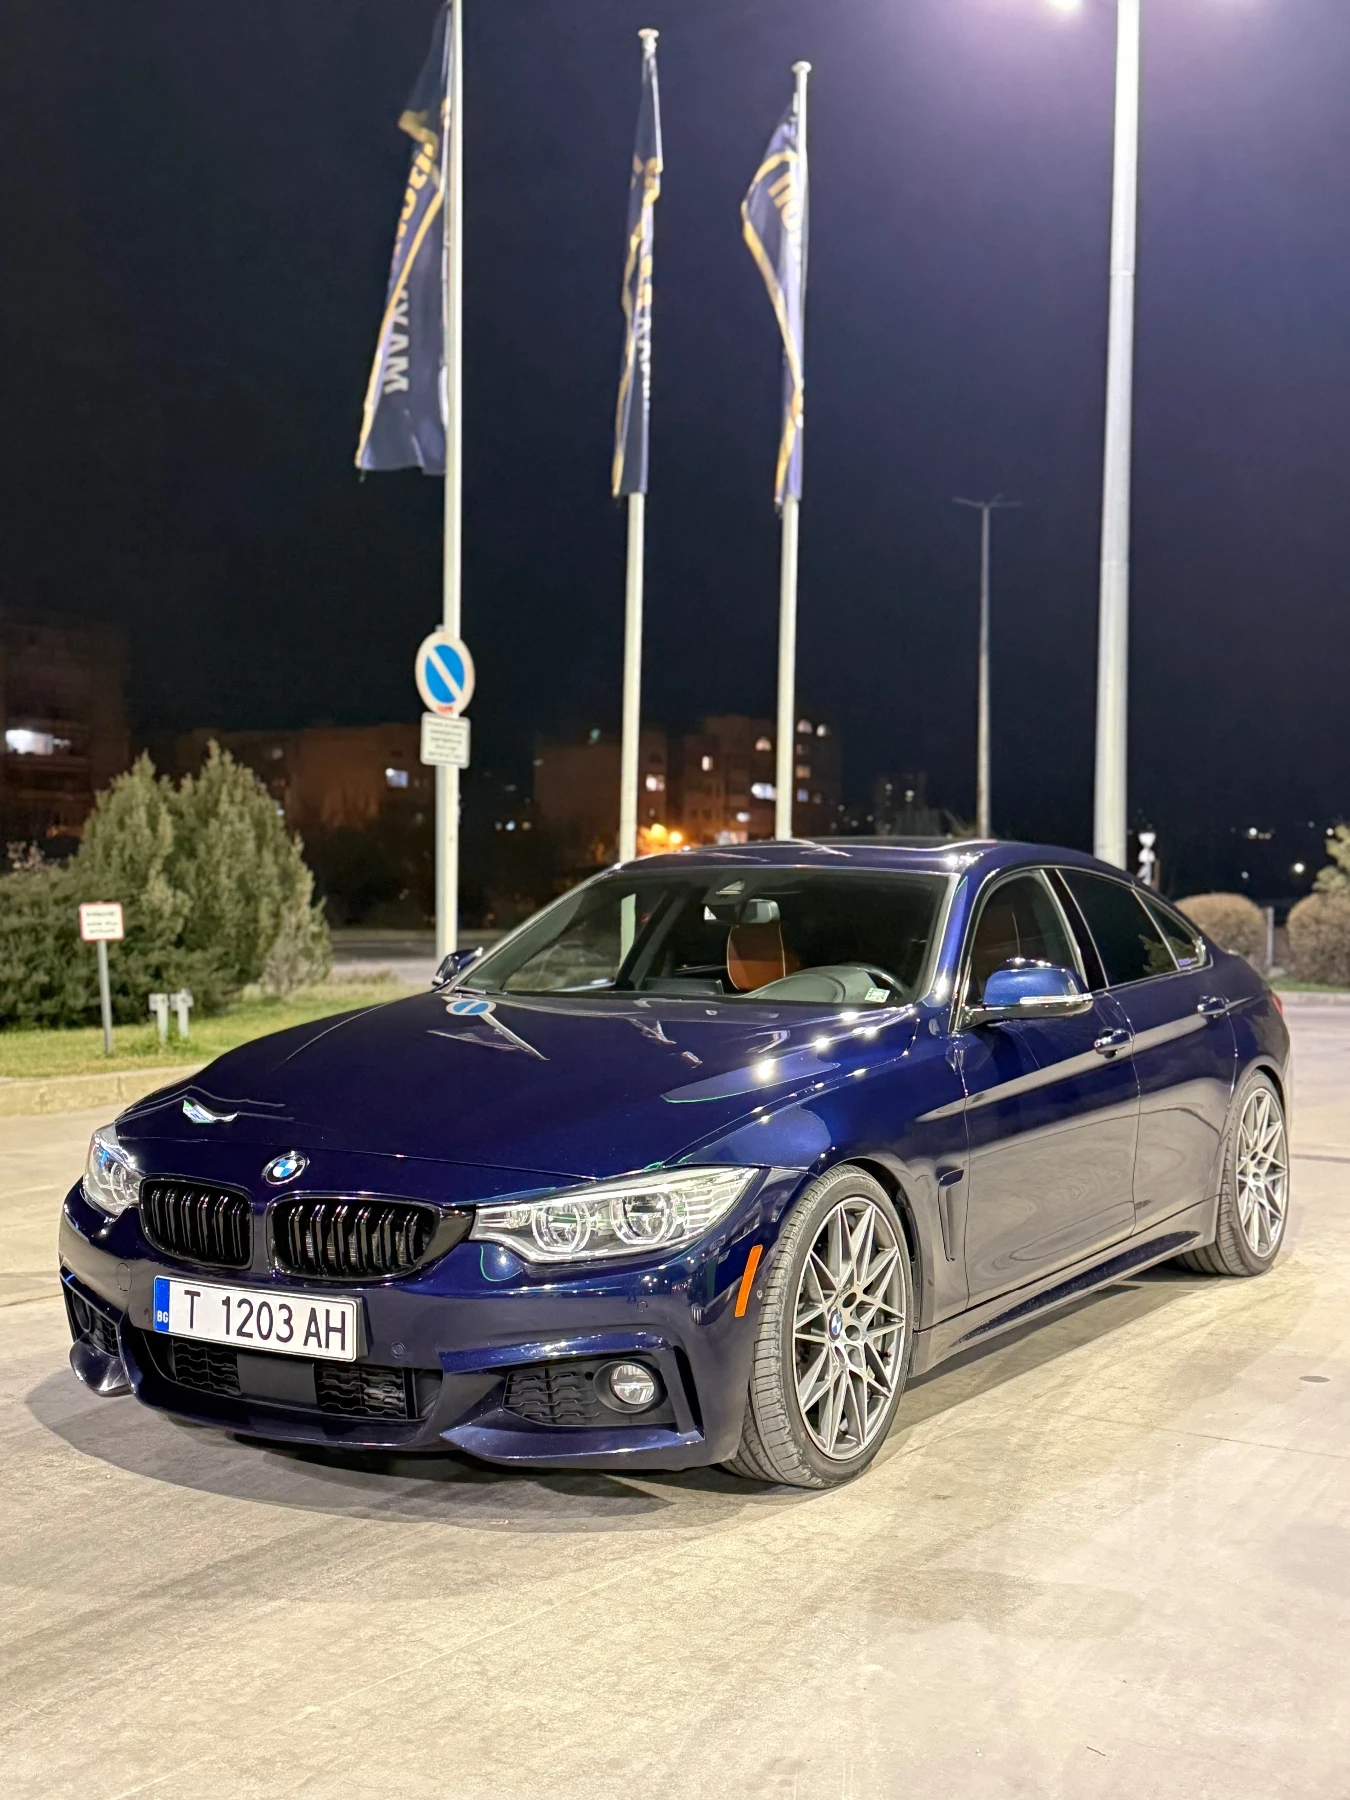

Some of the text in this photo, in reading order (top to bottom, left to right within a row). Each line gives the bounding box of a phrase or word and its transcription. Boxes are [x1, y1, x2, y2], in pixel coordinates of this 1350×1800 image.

[156, 1309, 169, 1324] BG
[183, 1289, 346, 1351] T 1203 AH
